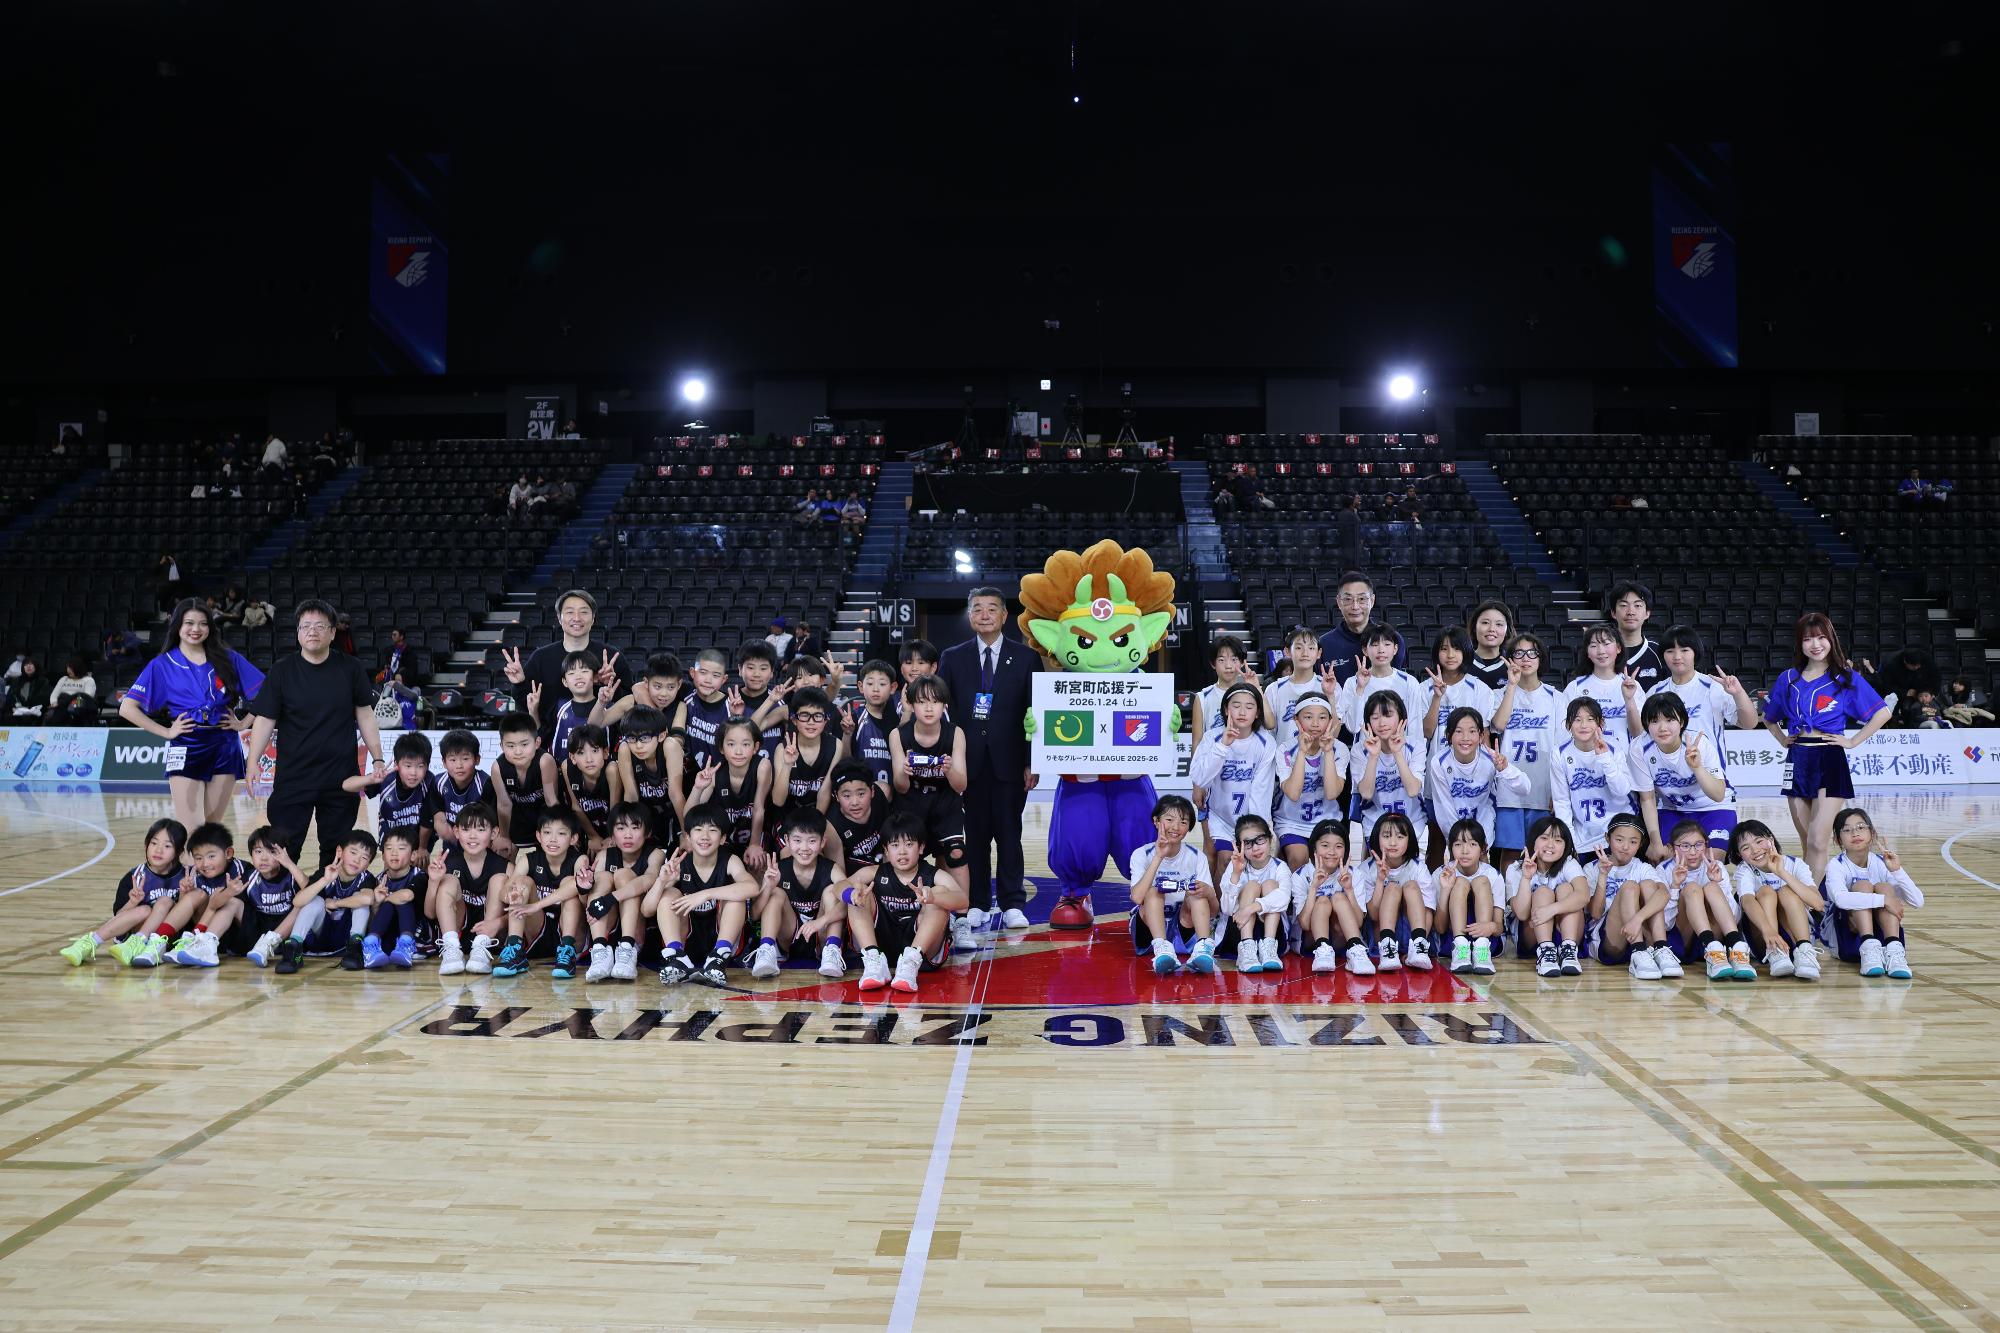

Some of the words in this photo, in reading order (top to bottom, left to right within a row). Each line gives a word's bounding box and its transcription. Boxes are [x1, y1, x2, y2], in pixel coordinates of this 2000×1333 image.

[536, 401, 549, 409] 2F
[527, 420, 555, 440] 2W
[878, 605, 894, 622] W
[899, 604, 911, 622] S
[1176, 608, 1188, 625] N
[1054, 680, 1153, 694] 新宮町応援デー
[1506, 713, 1550, 730] Beat
[1512, 741, 1538, 763] 75
[1232, 792, 1246, 815] 7
[1580, 799, 1606, 822] 73
